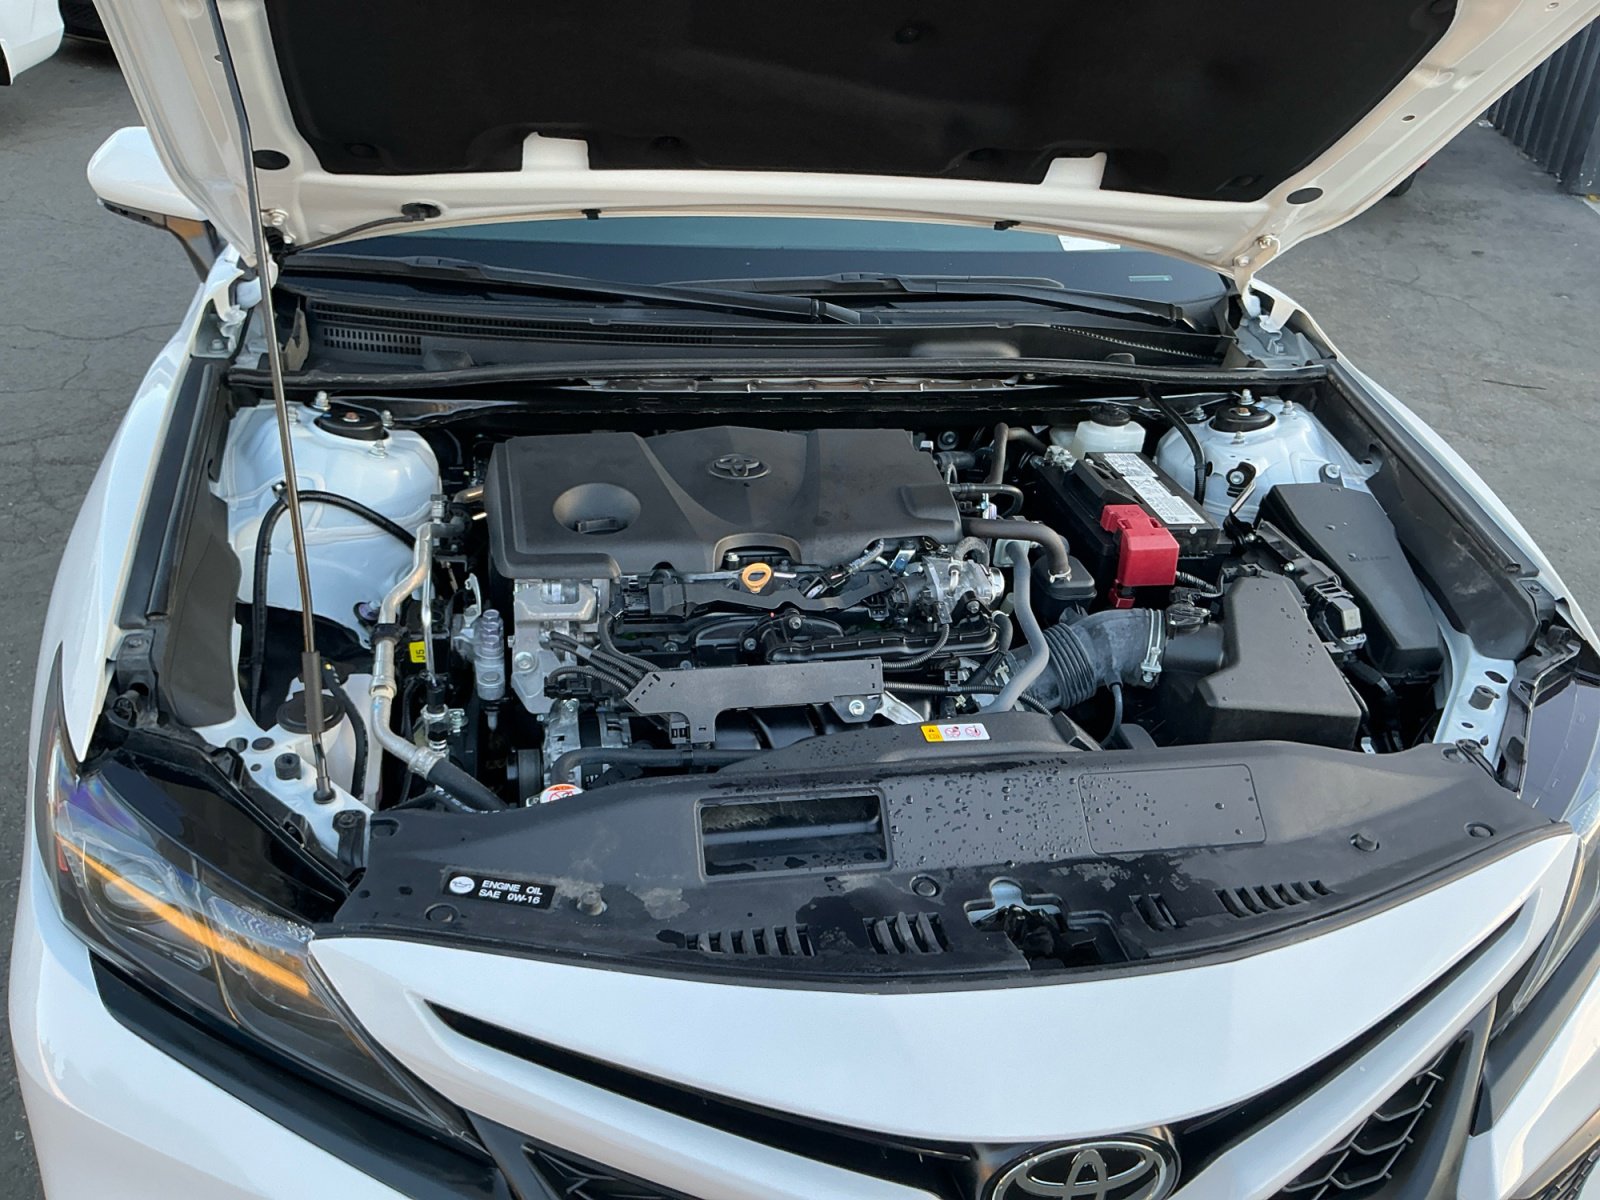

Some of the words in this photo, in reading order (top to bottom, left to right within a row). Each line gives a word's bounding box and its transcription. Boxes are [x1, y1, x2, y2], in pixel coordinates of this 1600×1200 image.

[481, 880, 521, 892] ENGINE
[526, 886, 543, 895] OIL
[478, 889, 501, 899] SAE
[507, 893, 540, 904] 0W-16
